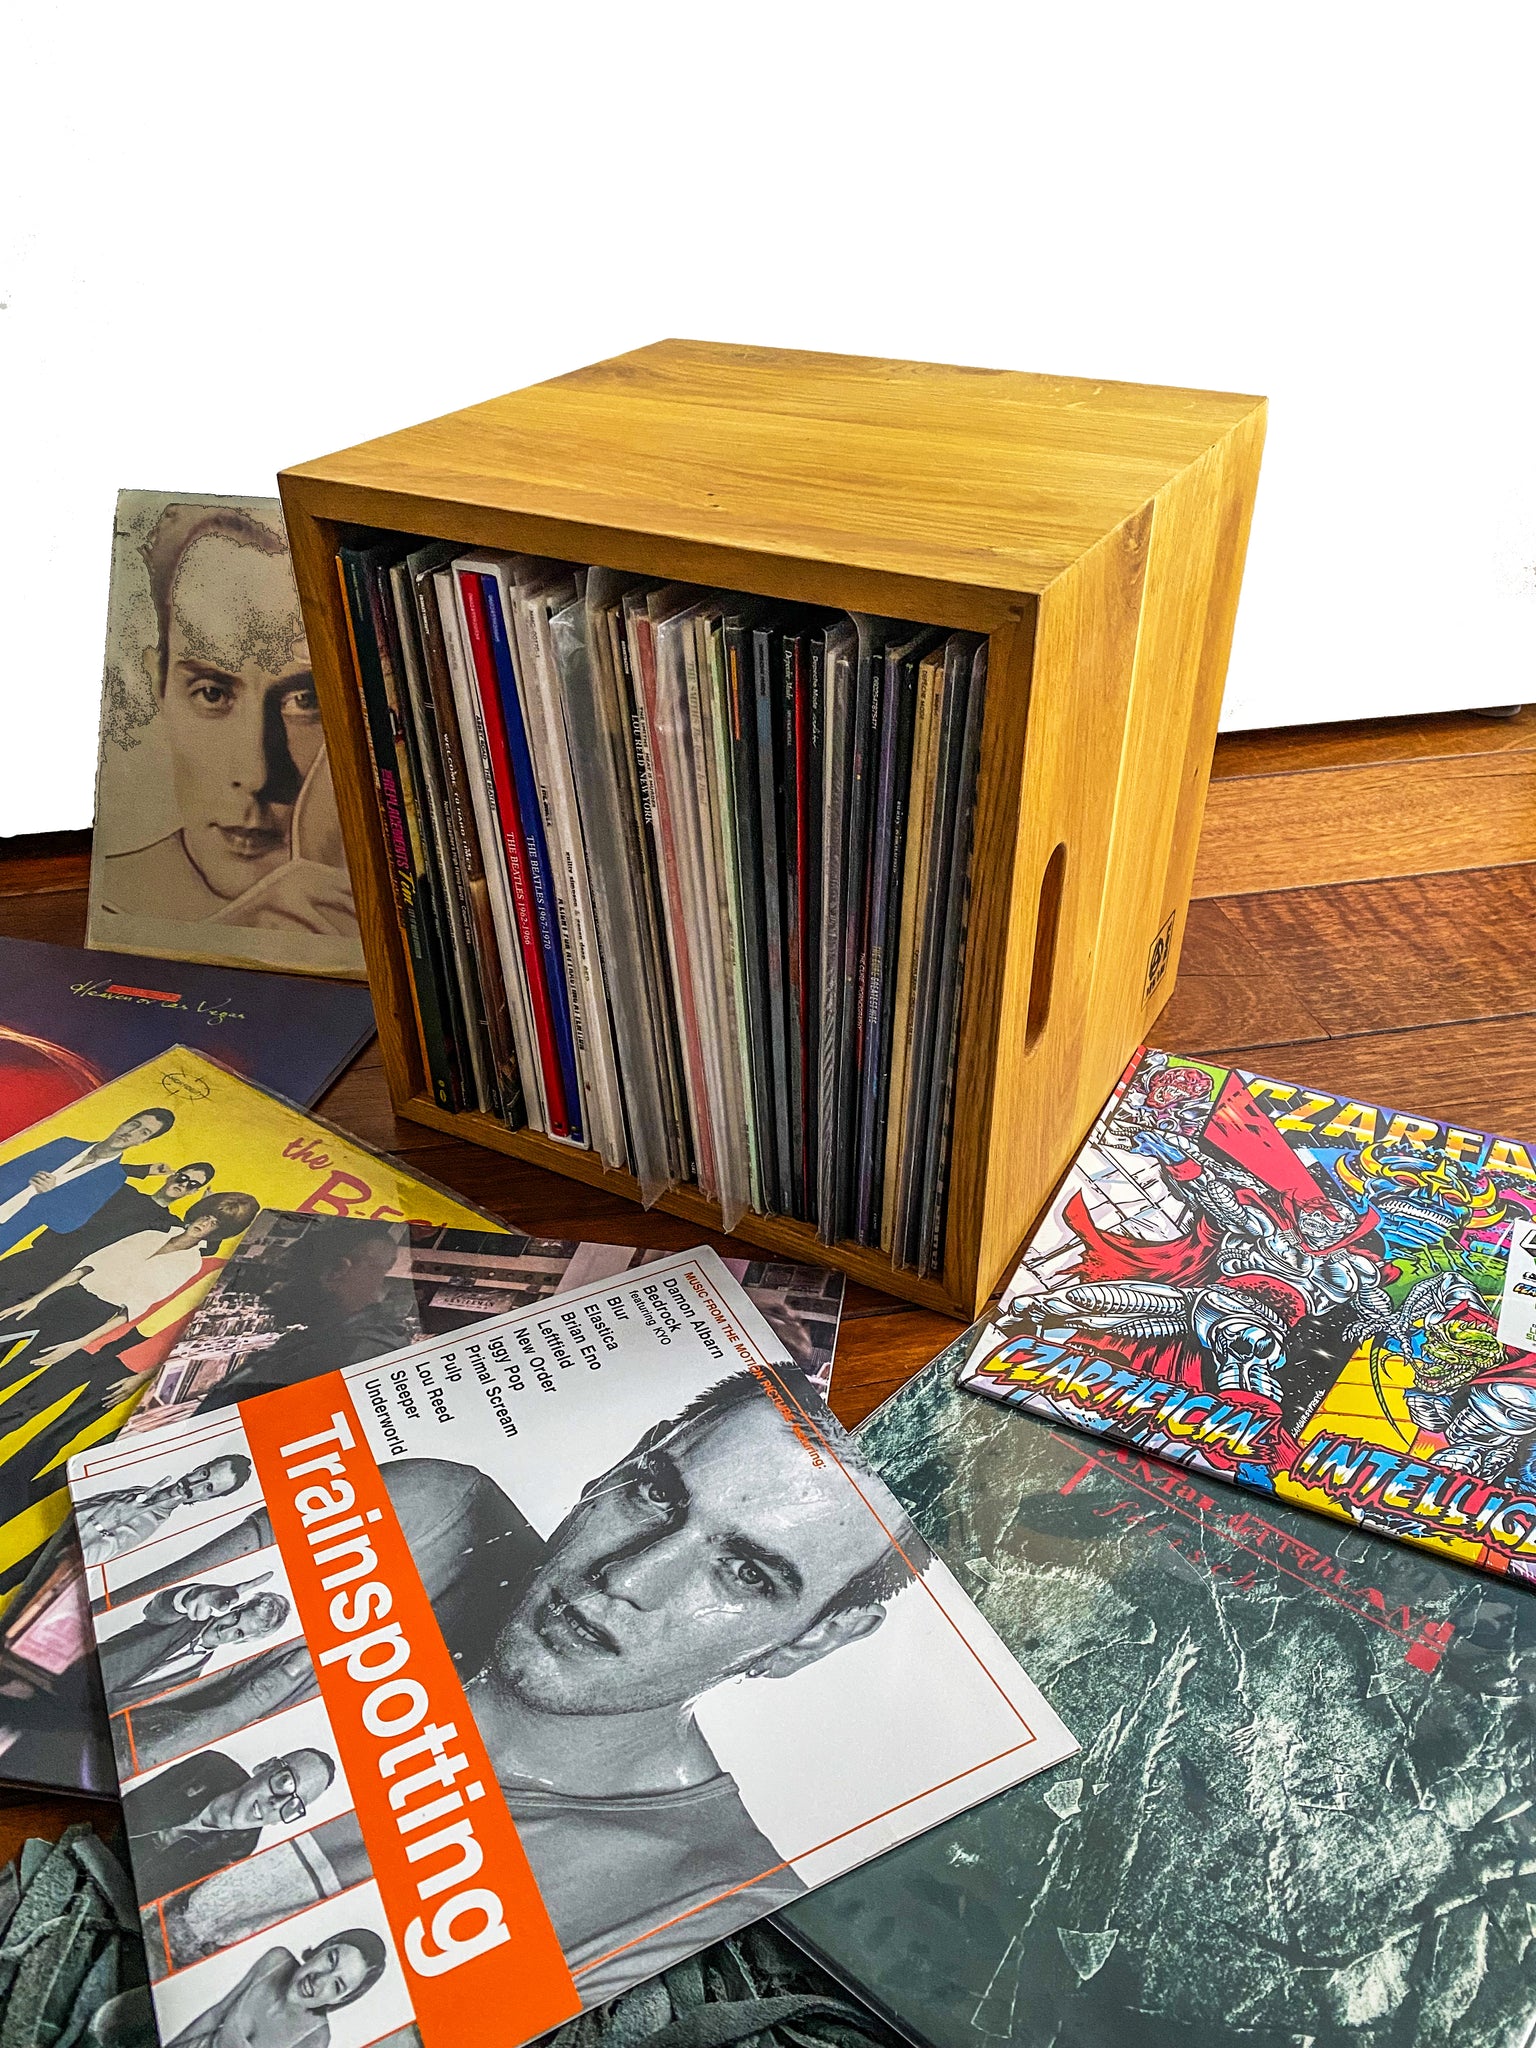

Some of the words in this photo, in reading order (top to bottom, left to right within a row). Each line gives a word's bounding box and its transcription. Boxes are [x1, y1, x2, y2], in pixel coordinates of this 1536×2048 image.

[785, 681, 793, 700] Mode
[475, 714, 483, 738] ABBEY
[631, 713, 641, 736] LOU
[635, 737, 645, 767] REED
[443, 733, 458, 785] WELCOME
[462, 840, 472, 872] TIMES
[639, 771, 649, 793] NEW
[642, 795, 653, 824] YORK
[506, 832, 517, 854] THE
[526, 835, 537, 858] THE
[398, 870, 416, 906] Tim
[510, 854, 525, 899] BEATLES
[531, 860, 544, 904] BEATLES
[519, 902, 531, 945] 1962-1966
[538, 906, 551, 950] 1967-1970
[858, 965, 866, 983] CURE
[869, 977, 879, 1009] GREATEST
[70, 979, 132, 1001] Heaven
[196, 998, 246, 1025] Vegas
[867, 1008, 877, 1024] HITS
[282, 1137, 334, 1170] the
[583, 1303, 619, 1352] Elastica
[606, 1296, 630, 1321] Blur
[629, 1289, 656, 1327] featuring
[653, 1325, 672, 1346] KYO
[642, 1285, 680, 1333] Bedrock
[662, 1277, 696, 1319] Damon
[690, 1319, 724, 1359] Albarn
[514, 1328, 536, 1356] New
[531, 1355, 558, 1394] Order
[537, 1319, 577, 1370] Leftfield
[560, 1311, 590, 1347] Brian
[581, 1346, 602, 1371] Eno
[684, 1271, 709, 1299] MUSIC
[702, 1298, 728, 1325] FROM
[721, 1323, 741, 1343] THE
[733, 1343, 766, 1381] MOTION
[759, 1379, 796, 1423] PICTURE
[440, 1353, 463, 1383] Pulp
[487, 1335, 515, 1367] Iggy
[501, 1364, 526, 1392] Pop
[390, 1371, 421, 1421] Sleeper
[415, 1362, 435, 1386] Lou
[427, 1387, 454, 1424] Reed
[465, 1344, 495, 1386] Primal
[486, 1385, 518, 1438] Scream
[983, 1337, 1273, 1457] CZARTIFICIAL
[364, 1378, 408, 1456] Underworld
[278, 1411, 512, 1978] Trainspotting
